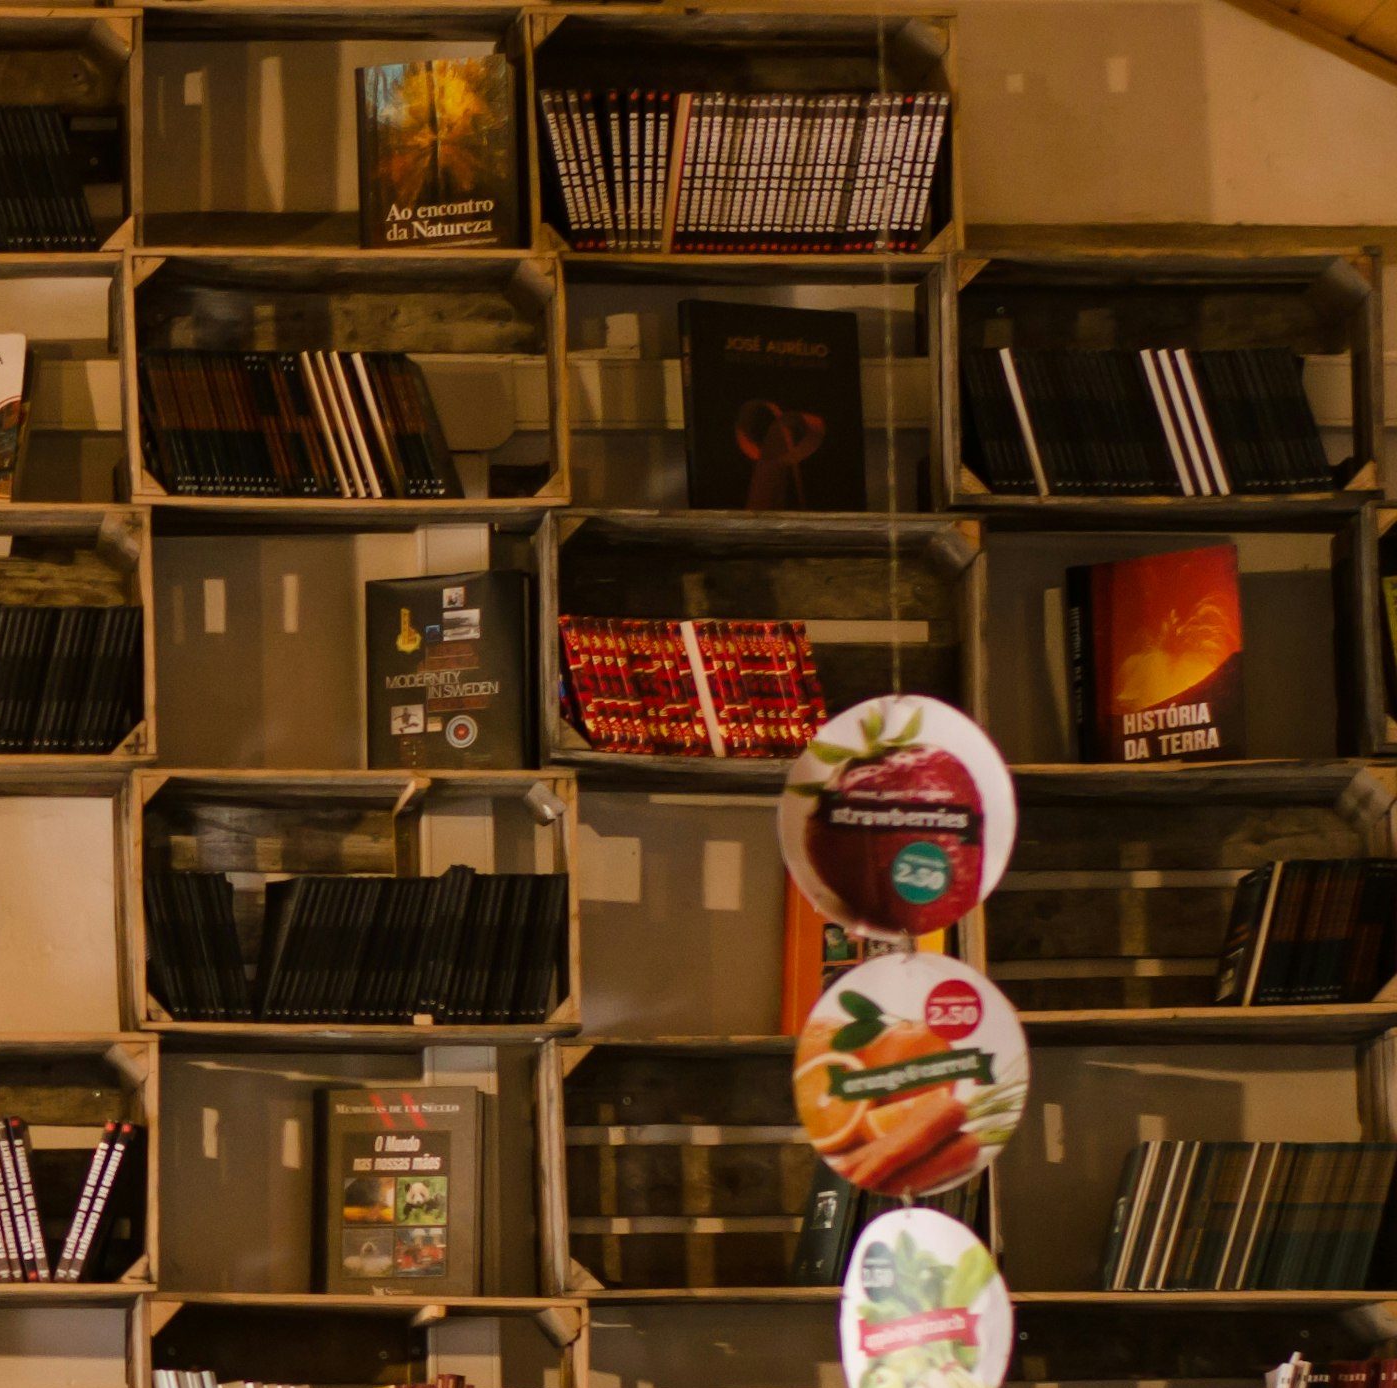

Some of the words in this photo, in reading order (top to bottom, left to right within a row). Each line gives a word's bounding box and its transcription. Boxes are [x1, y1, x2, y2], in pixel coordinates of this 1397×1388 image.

[386, 203, 412, 221] Ao
[416, 199, 494, 218] encontro
[386, 224, 408, 241] da
[413, 220, 493, 239] Natureza
[726, 336, 761, 352] JOSÉ
[766, 339, 829, 357] AURÉLIO
[385, 670, 461, 689] MODERNITY
[428, 685, 442, 699] IN
[443, 682, 499, 699] SWEDEN
[1122, 702, 1211, 735] HISTÓRIA
[1123, 737, 1149, 761] DA
[1160, 727, 1219, 758] TERRA
[831, 808, 967, 829] strawberries
[928, 1005, 979, 1026] 2.50
[374, 1135, 384, 1152] O
[386, 1135, 420, 1152] Mundo
[353, 1157, 373, 1171] nas
[374, 1156, 411, 1171] nossas
[412, 1152, 441, 1171] mãos
